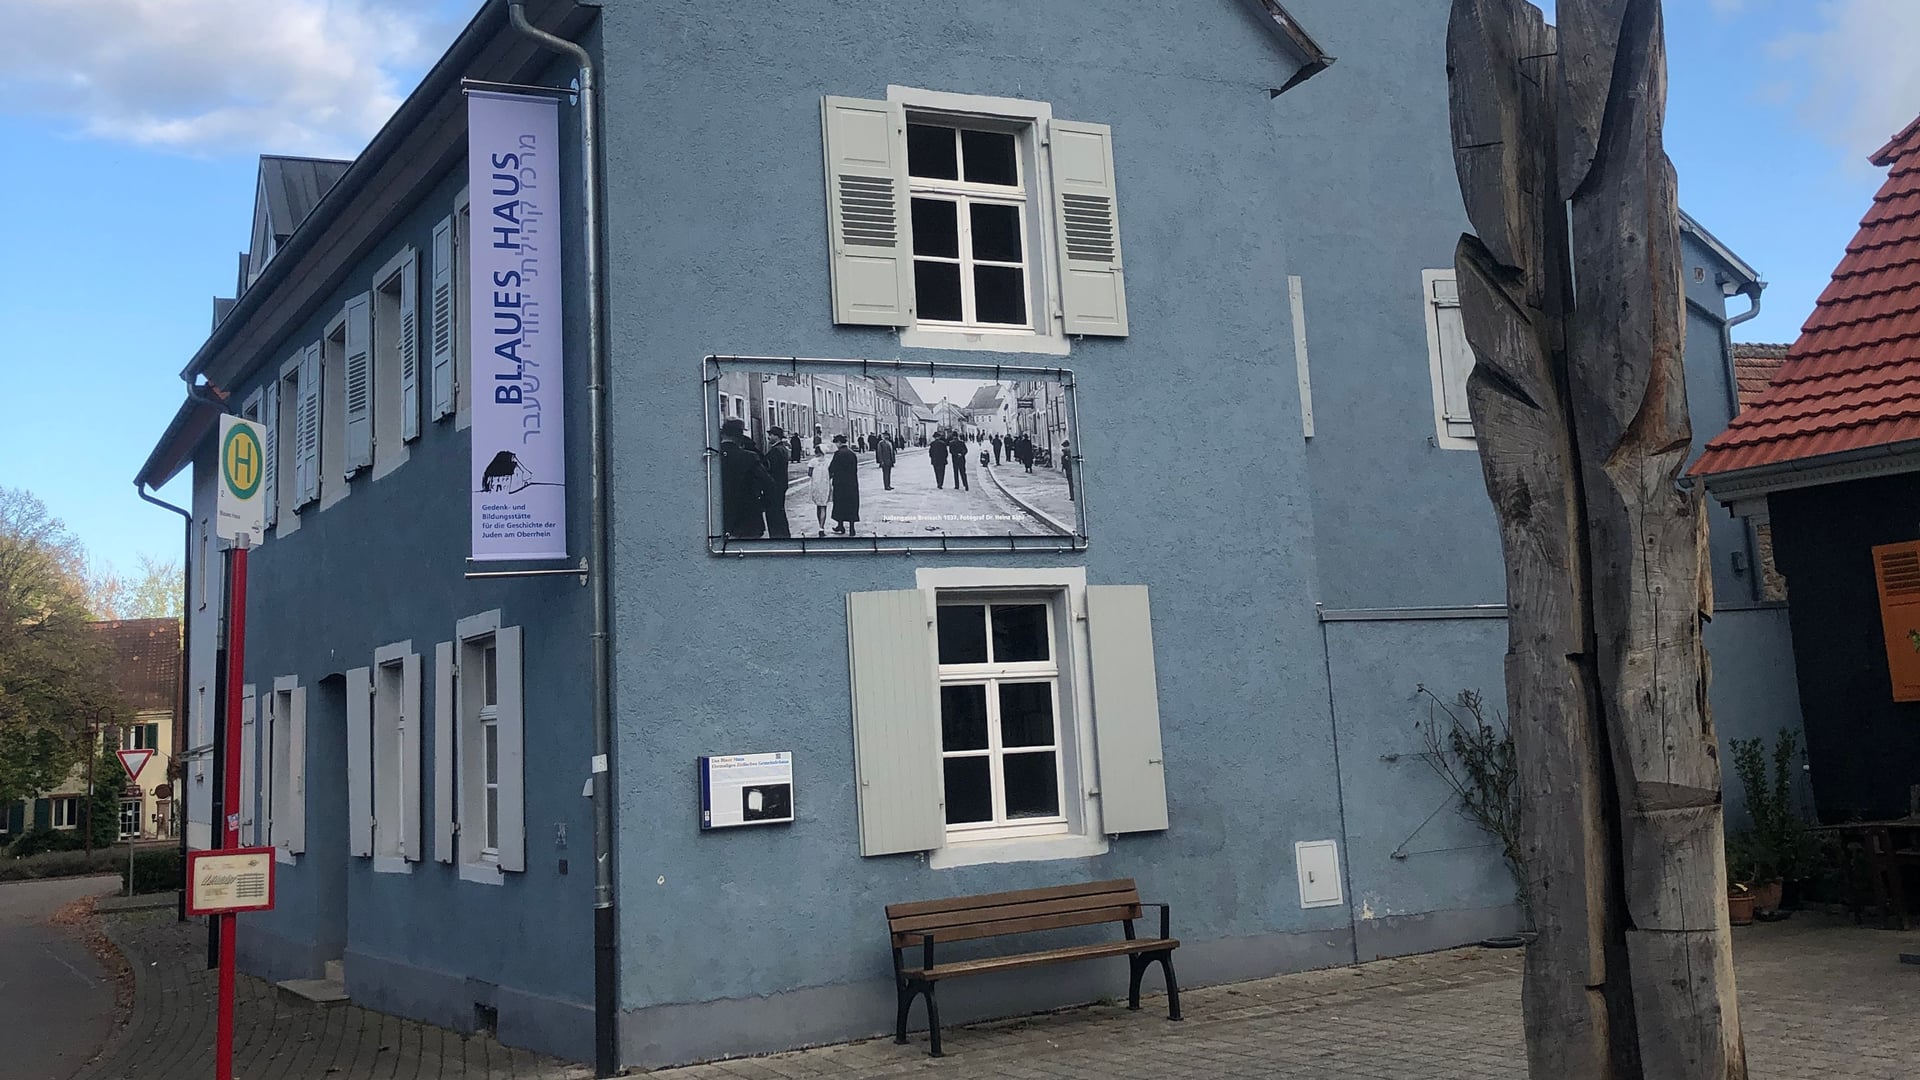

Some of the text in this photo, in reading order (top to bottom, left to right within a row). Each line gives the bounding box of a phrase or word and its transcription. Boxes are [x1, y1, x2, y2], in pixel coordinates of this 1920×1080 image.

[492, 153, 523, 404] BLAUES HAUS
[235, 439, 252, 483] H
[482, 513, 531, 521] Bildungsstätte
[482, 531, 502, 539] Juden
[516, 530, 551, 538] Oberrhein
